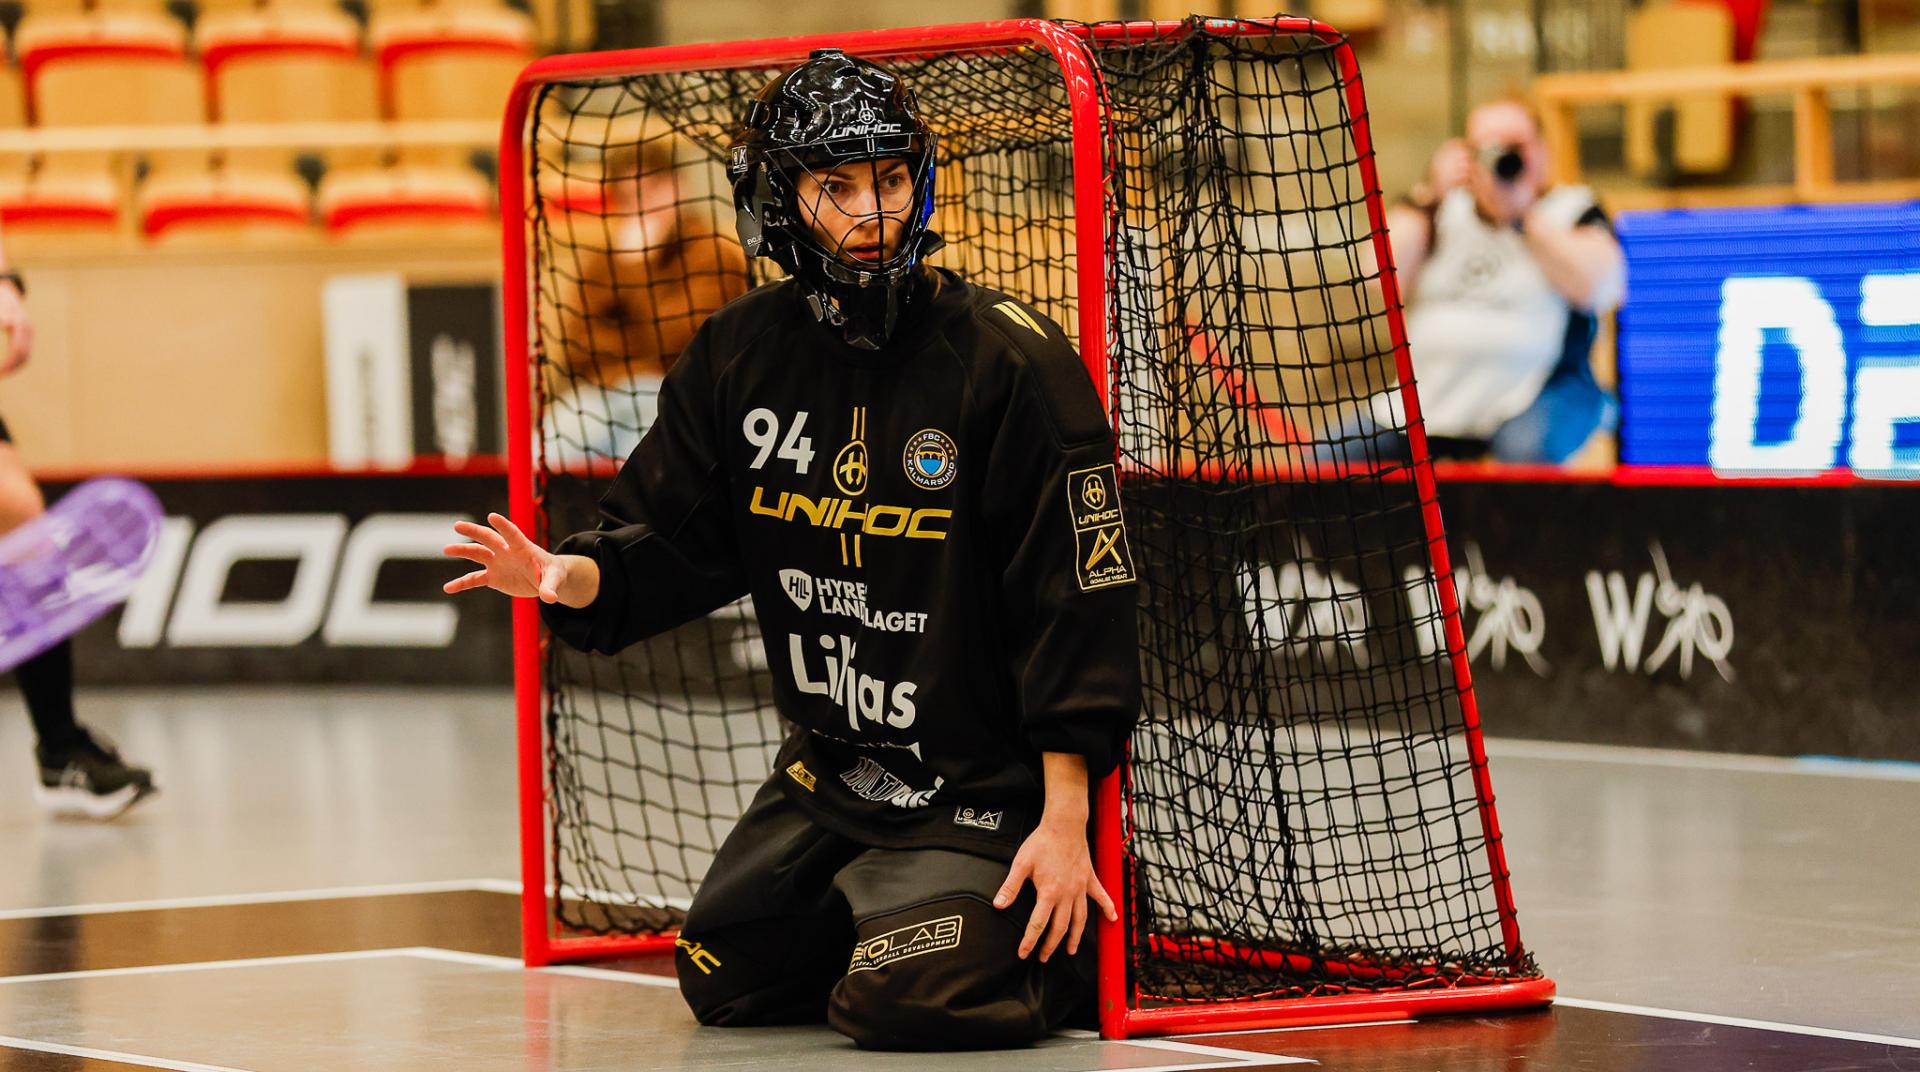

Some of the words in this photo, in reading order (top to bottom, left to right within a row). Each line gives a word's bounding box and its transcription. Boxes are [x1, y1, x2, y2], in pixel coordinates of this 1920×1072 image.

[831, 123, 901, 138] UNIHOC
[742, 408, 816, 475] 94
[923, 433, 940, 442] FBC
[907, 459, 954, 486] KALMARSUND
[750, 486, 953, 540] UNIHOC
[1078, 509, 1119, 524] UNIHOC
[1089, 565, 1127, 578] ALPHA
[815, 577, 868, 601] HYRE
[789, 633, 918, 731] Liljas
[903, 937, 955, 954] DEVELOPMENT
